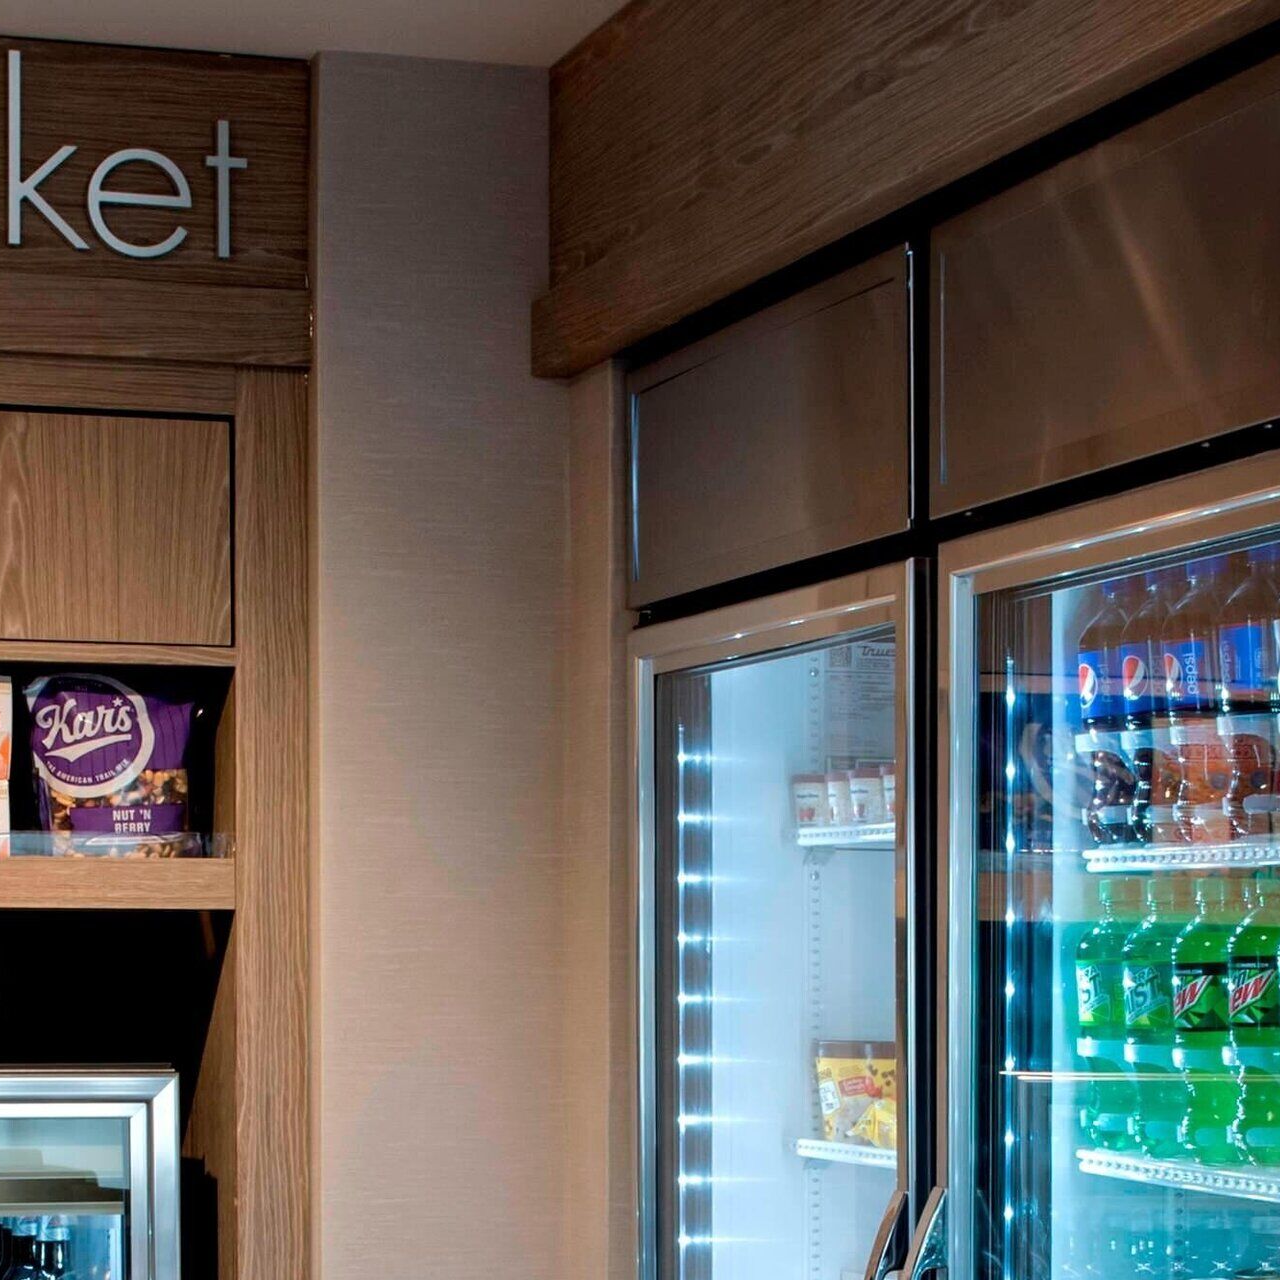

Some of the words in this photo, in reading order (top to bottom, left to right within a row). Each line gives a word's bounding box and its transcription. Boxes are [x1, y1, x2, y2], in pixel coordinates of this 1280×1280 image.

[1182, 652, 1199, 695] pepsi
[112, 809, 135, 822] NUT
[114, 822, 151, 834] BERRY
